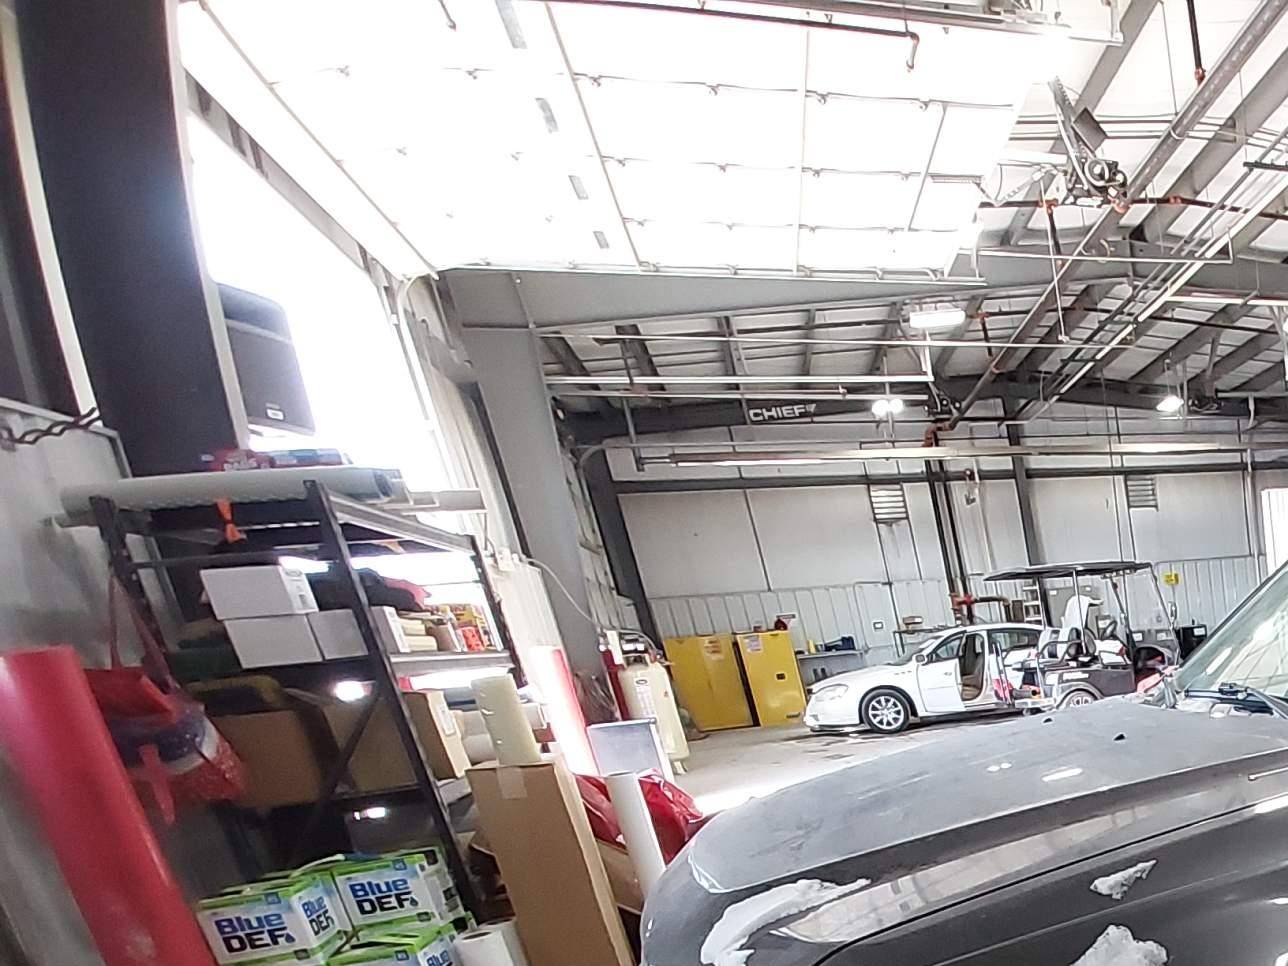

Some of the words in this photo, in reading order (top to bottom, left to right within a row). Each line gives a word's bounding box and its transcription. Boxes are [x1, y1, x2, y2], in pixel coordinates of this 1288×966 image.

[748, 404, 806, 421] CHIEF
[349, 878, 411, 899] Blue
[301, 895, 327, 919] Blue
[355, 891, 413, 915] DEF
[214, 913, 286, 936] Blue
[222, 926, 288, 954] DEF
